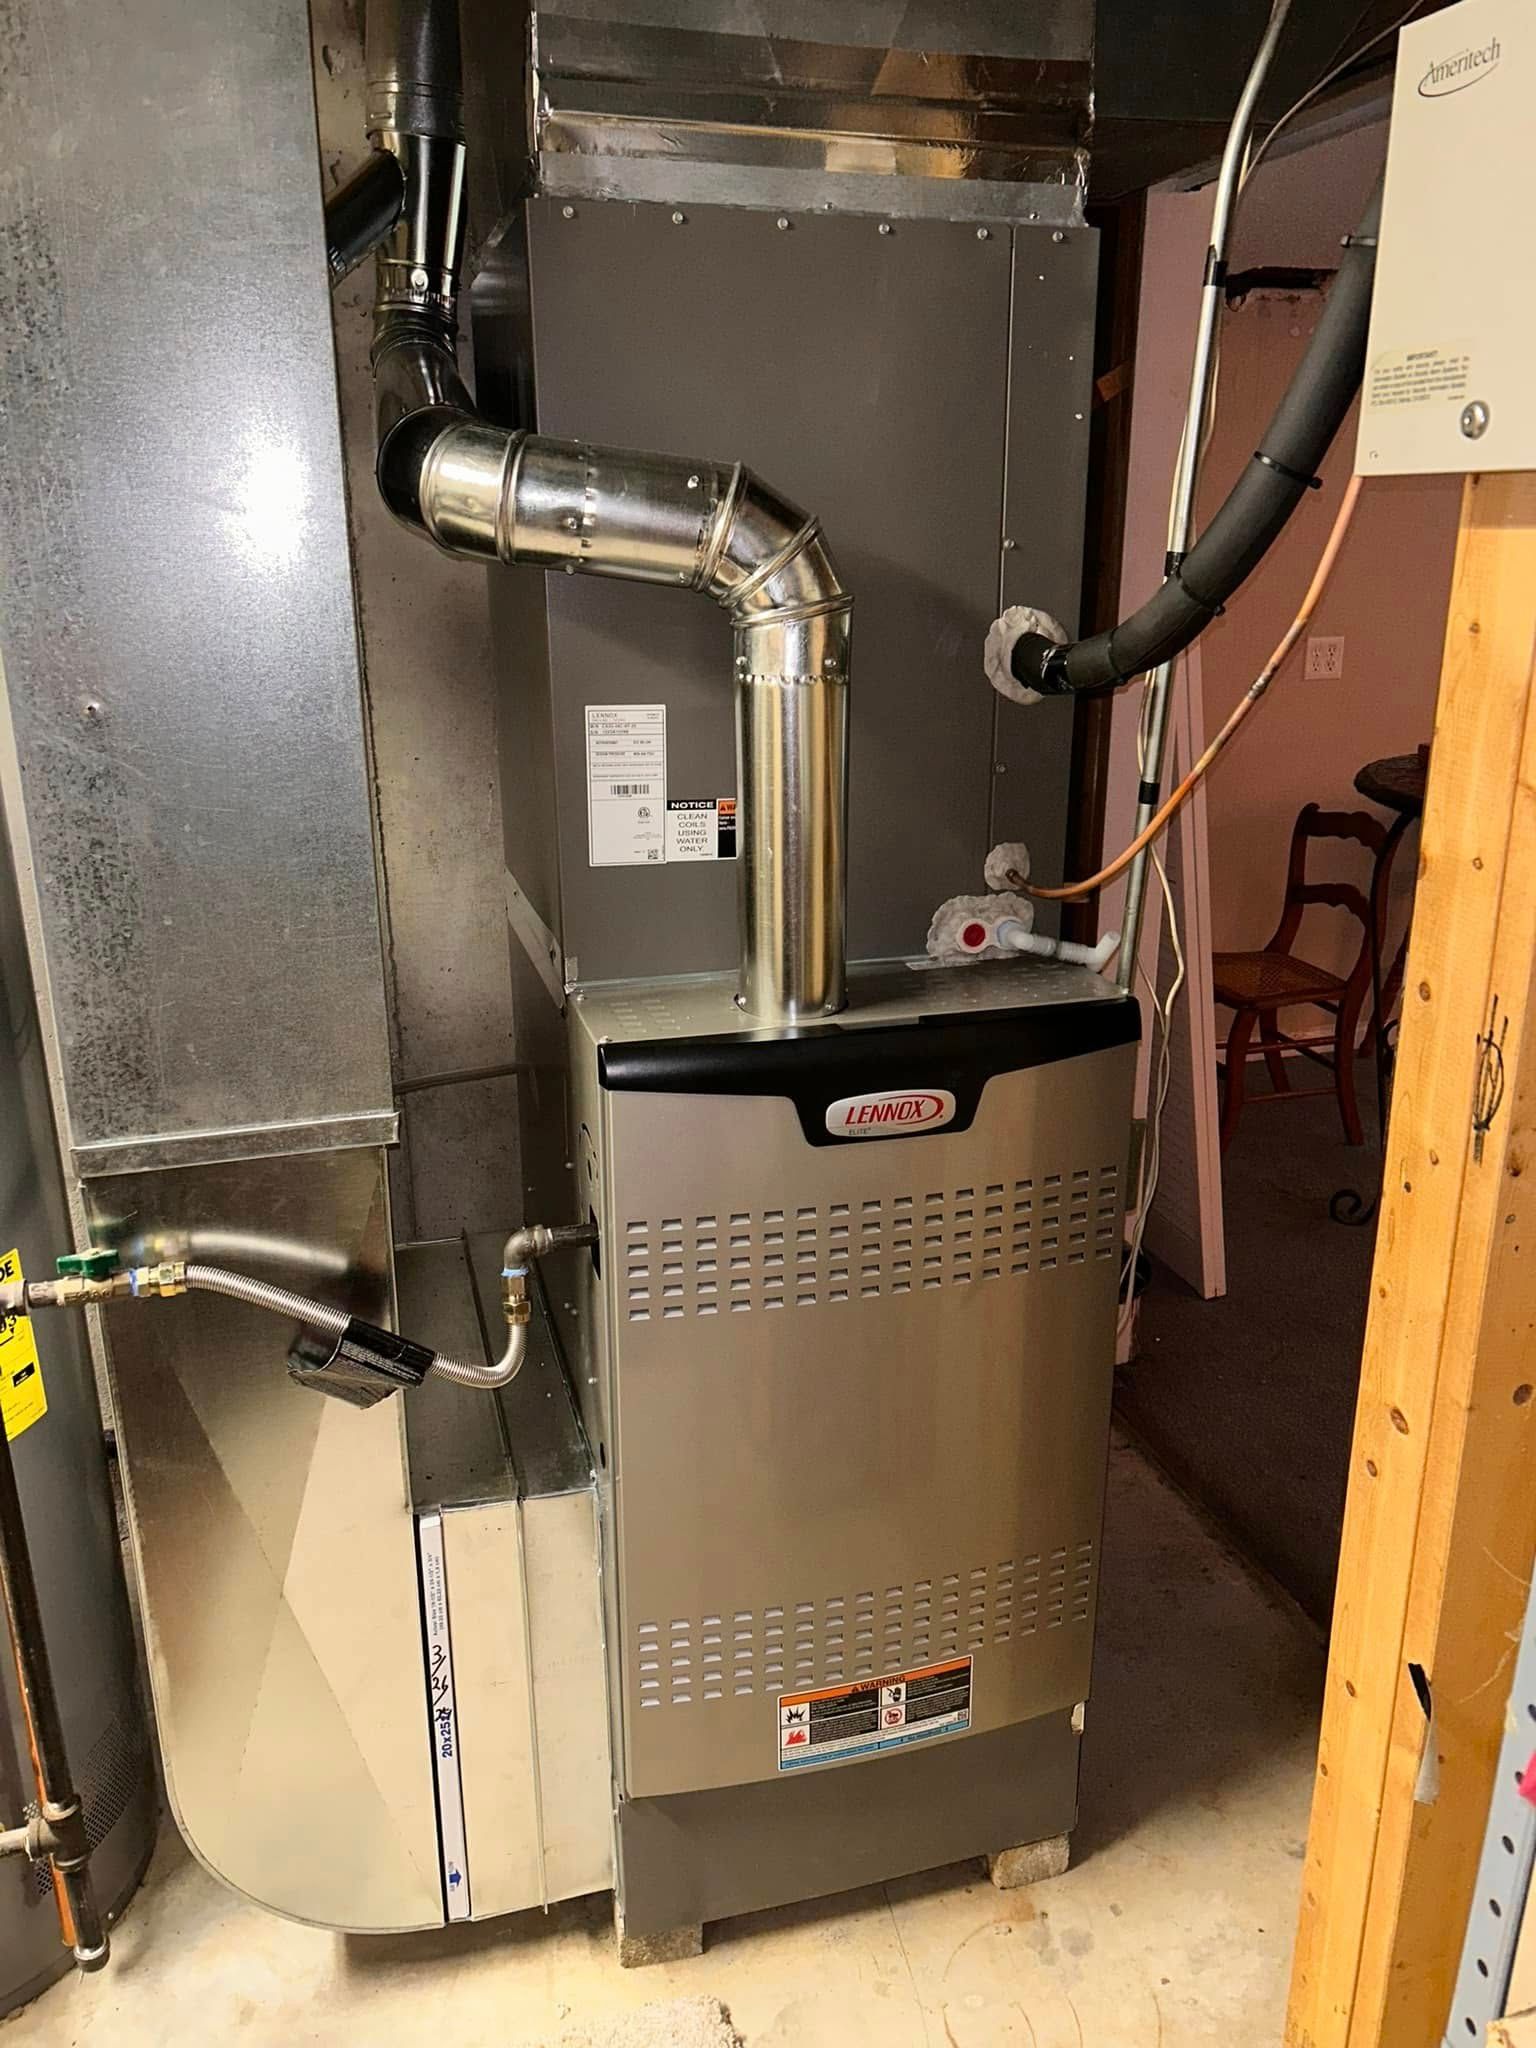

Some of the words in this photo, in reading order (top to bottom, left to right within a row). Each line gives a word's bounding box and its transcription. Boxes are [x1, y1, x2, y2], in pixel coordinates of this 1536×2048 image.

[1422, 37, 1500, 86] Ameritech
[671, 801, 714, 809] NOTICE
[845, 1100, 925, 1125] LENNOX
[861, 1676, 906, 1692] WARNING
